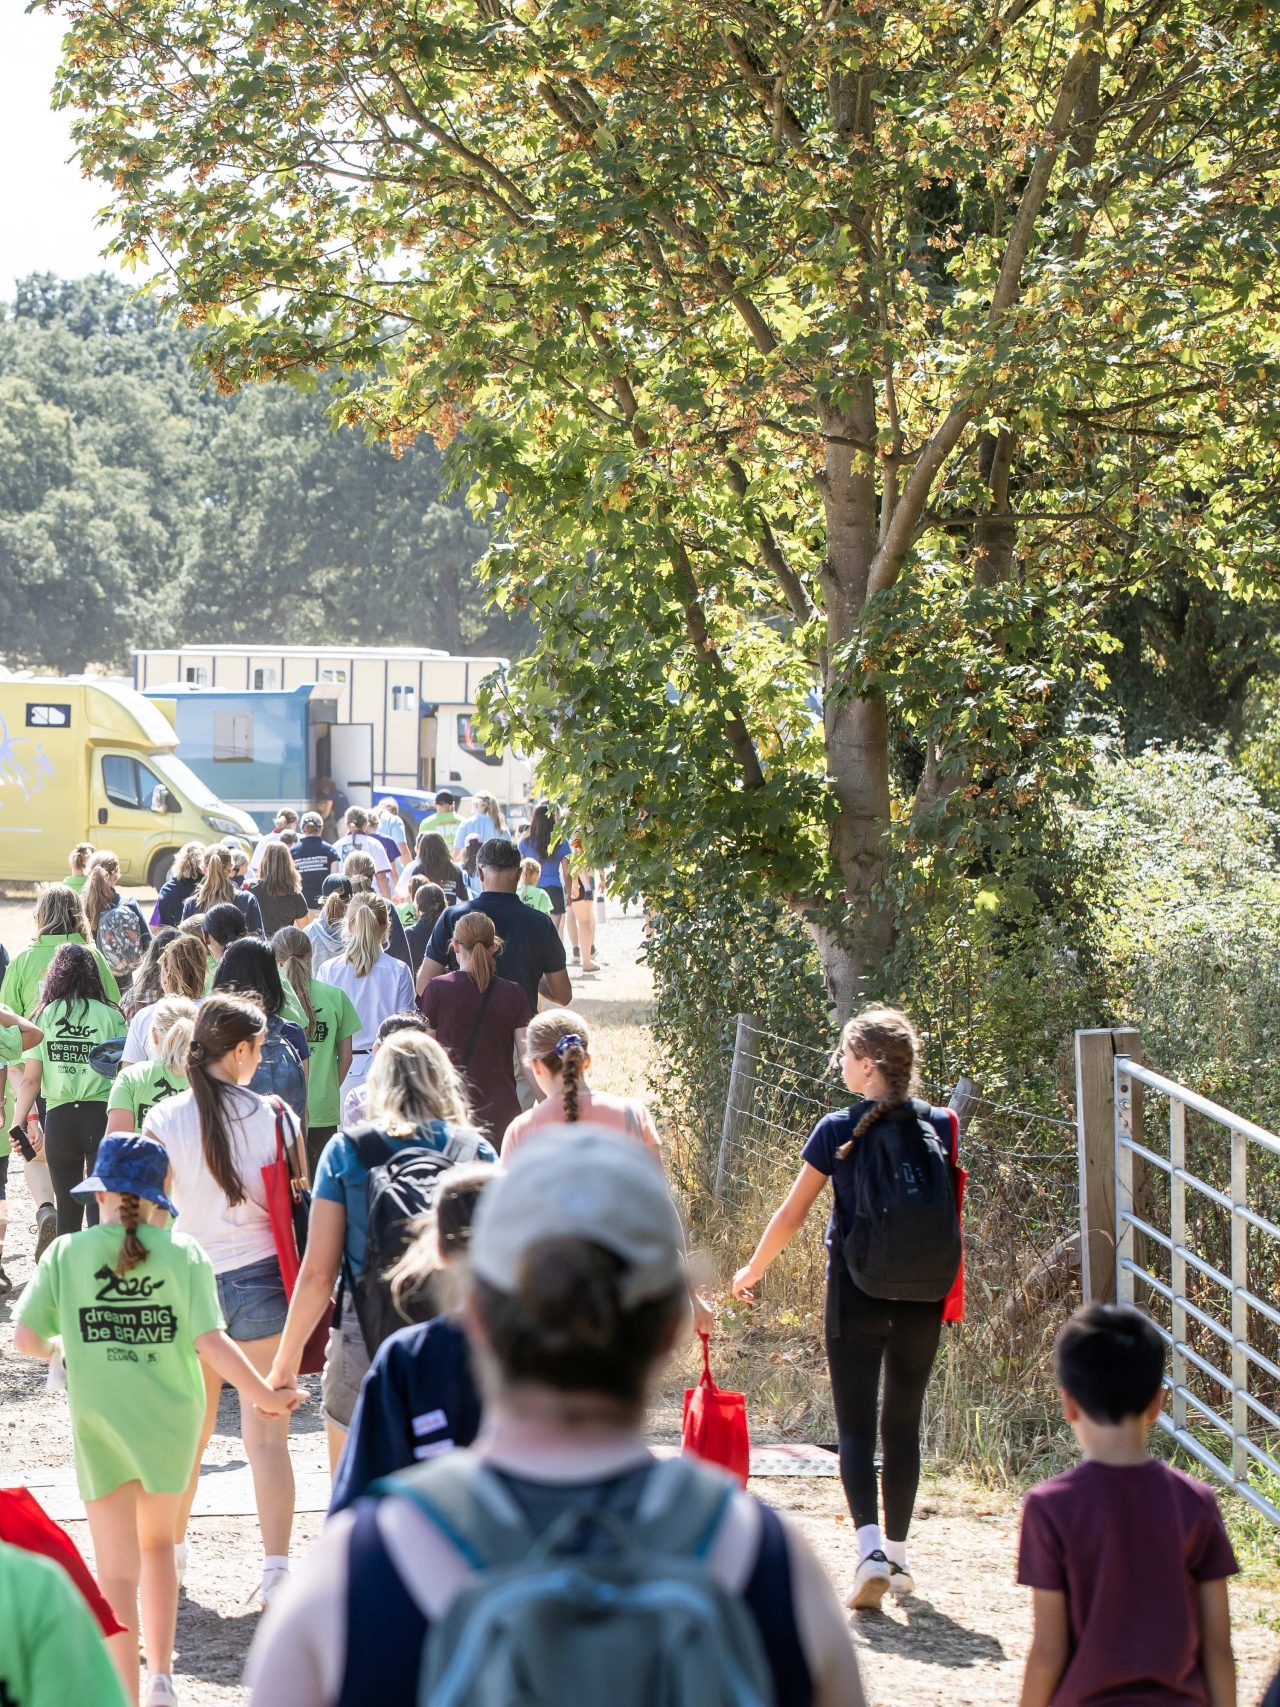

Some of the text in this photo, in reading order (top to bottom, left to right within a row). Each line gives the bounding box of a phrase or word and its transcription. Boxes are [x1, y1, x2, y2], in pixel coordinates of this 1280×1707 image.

[50, 1042, 79, 1052] dream
[51, 1052, 90, 1063] be BRAV
[94, 1263, 166, 1302] 2026
[85, 1309, 171, 1325] dream BIG
[87, 1326, 173, 1343] be BRAVE
